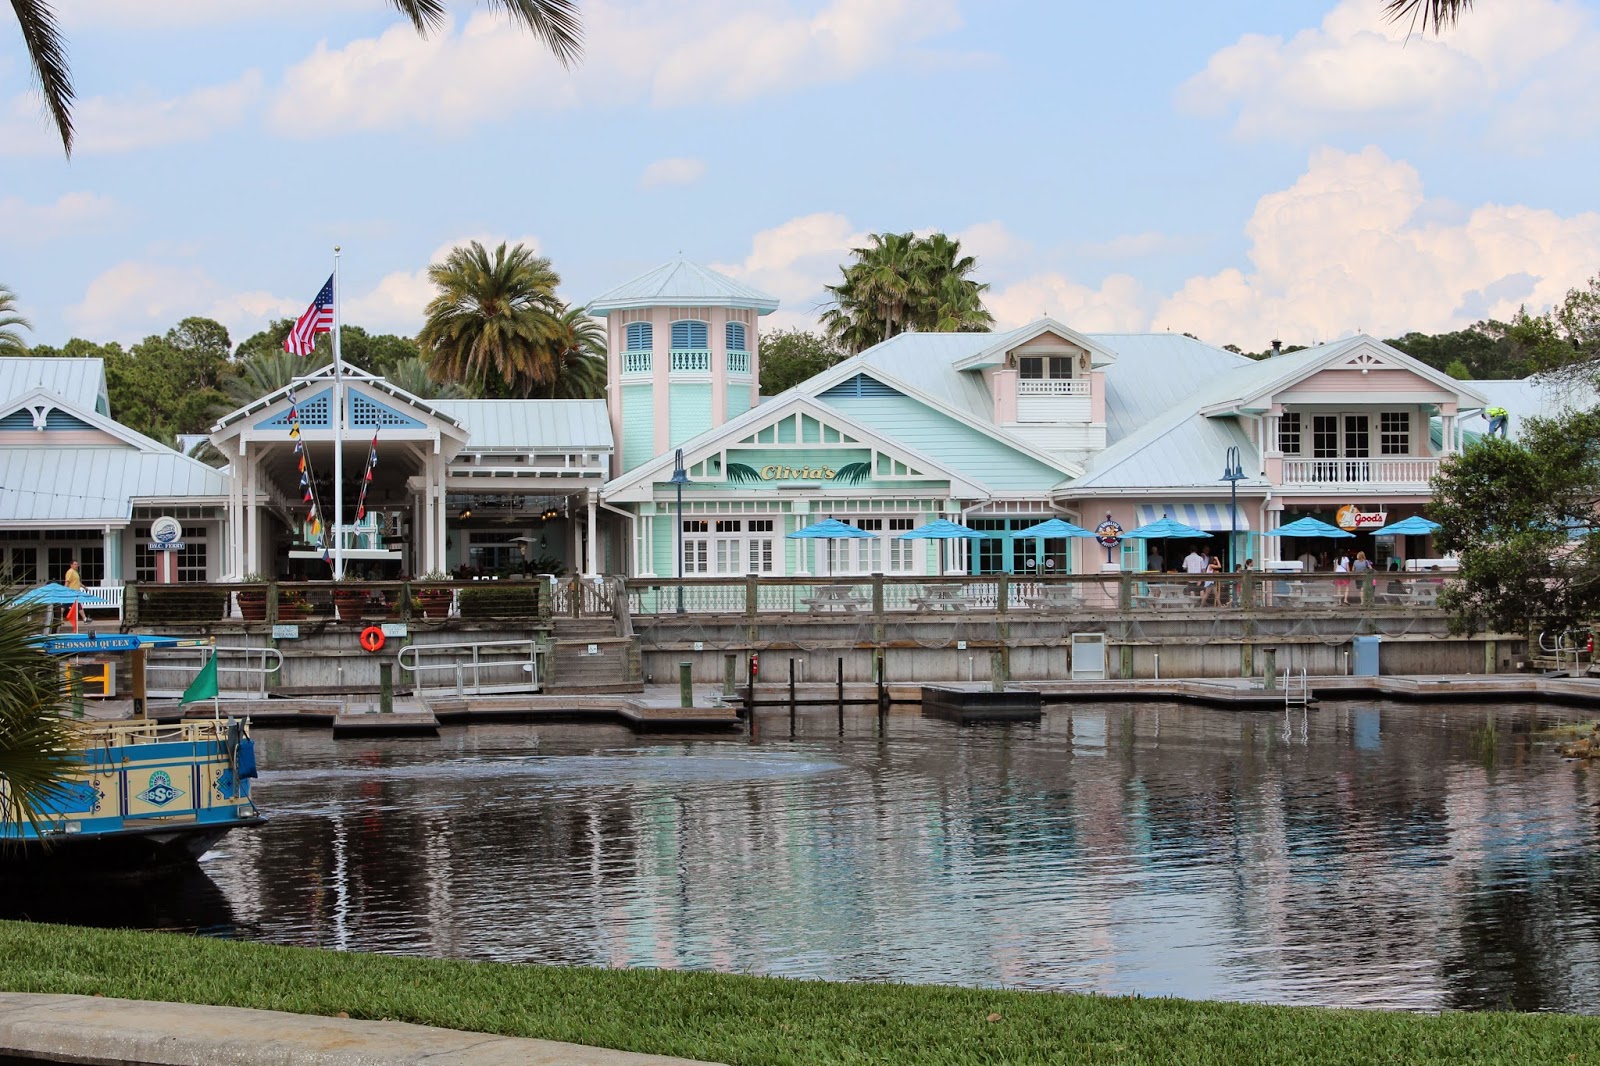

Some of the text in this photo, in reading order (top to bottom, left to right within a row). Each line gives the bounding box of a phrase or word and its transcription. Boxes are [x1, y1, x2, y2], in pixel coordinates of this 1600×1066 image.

[761, 465, 836, 480] Olivia's
[1354, 513, 1383, 527] Good's
[54, 639, 129, 650] BLOSSOM QUEEN
